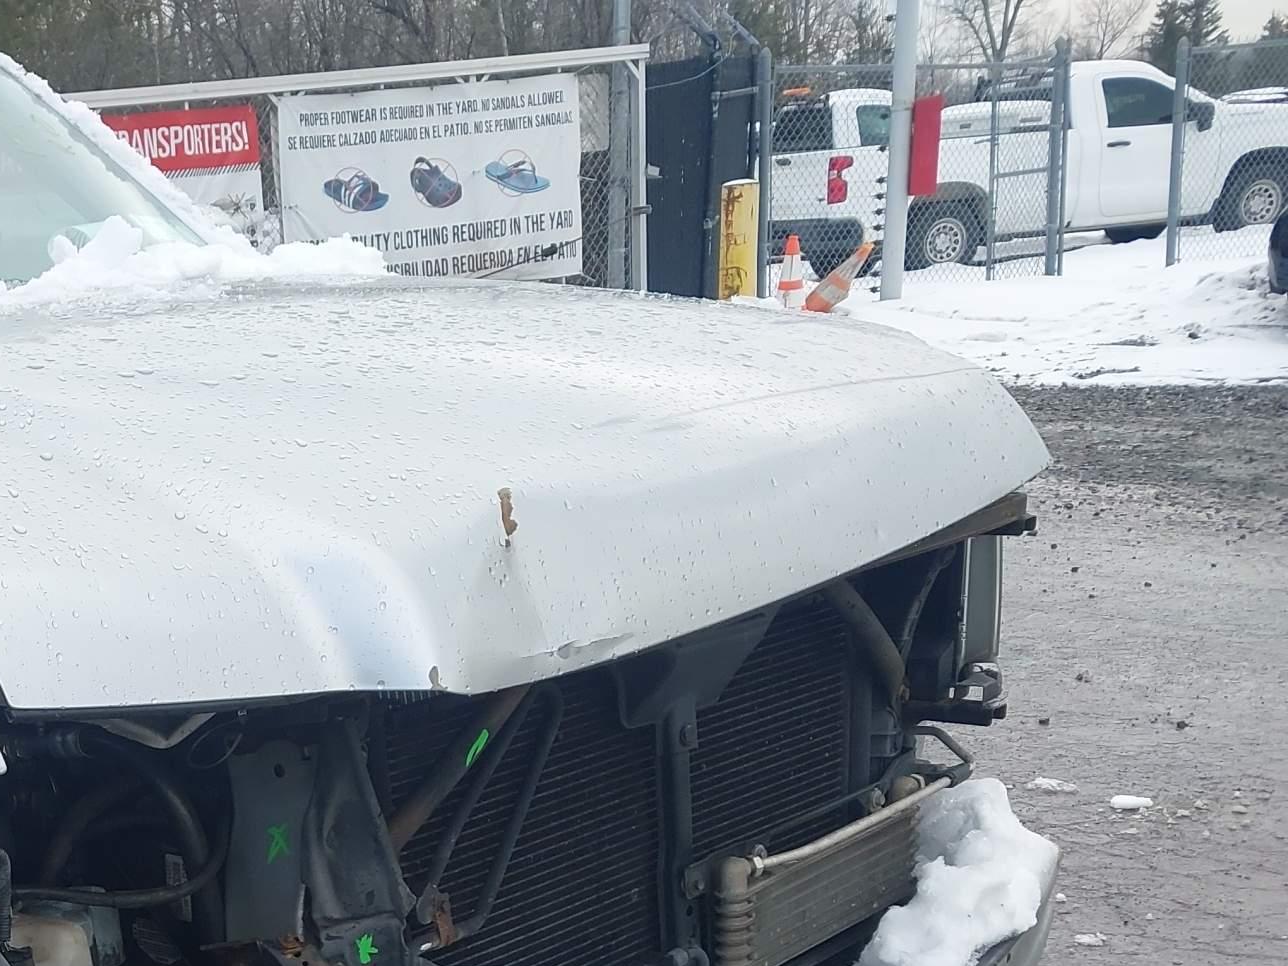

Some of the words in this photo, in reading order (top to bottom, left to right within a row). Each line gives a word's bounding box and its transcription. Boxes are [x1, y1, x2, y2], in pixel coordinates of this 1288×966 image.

[299, 112, 329, 127] PROPER
[331, 108, 377, 125] FOOTWEAR
[379, 107, 387, 120] IS
[389, 104, 424, 121] REQUIRED
[425, 104, 435, 117] IN
[436, 102, 453, 116] THE
[481, 98, 490, 112] NO
[491, 94, 526, 111] SANDALS
[114, 121, 249, 160] ANSPORTERS!
[287, 136, 298, 150] SE
[299, 133, 337, 150] REQUIERE
[338, 130, 377, 147] CALZADO
[379, 127, 418, 143] ADECUADO
[419, 126, 431, 140] EN
[432, 125, 442, 139] EL
[473, 120, 483, 134] NO
[484, 119, 493, 133] SE
[494, 115, 533, 132] PERMITEN
[393, 225, 449, 250] CLOTHING
[452, 218, 507, 243] REQUIRED
[510, 215, 521, 236] IN
[524, 213, 546, 234] THE
[549, 209, 573, 230] YARD
[383, 257, 449, 277] SIBILIDAD
[452, 248, 512, 276] REQUERIDA
[516, 245, 531, 264] EN
